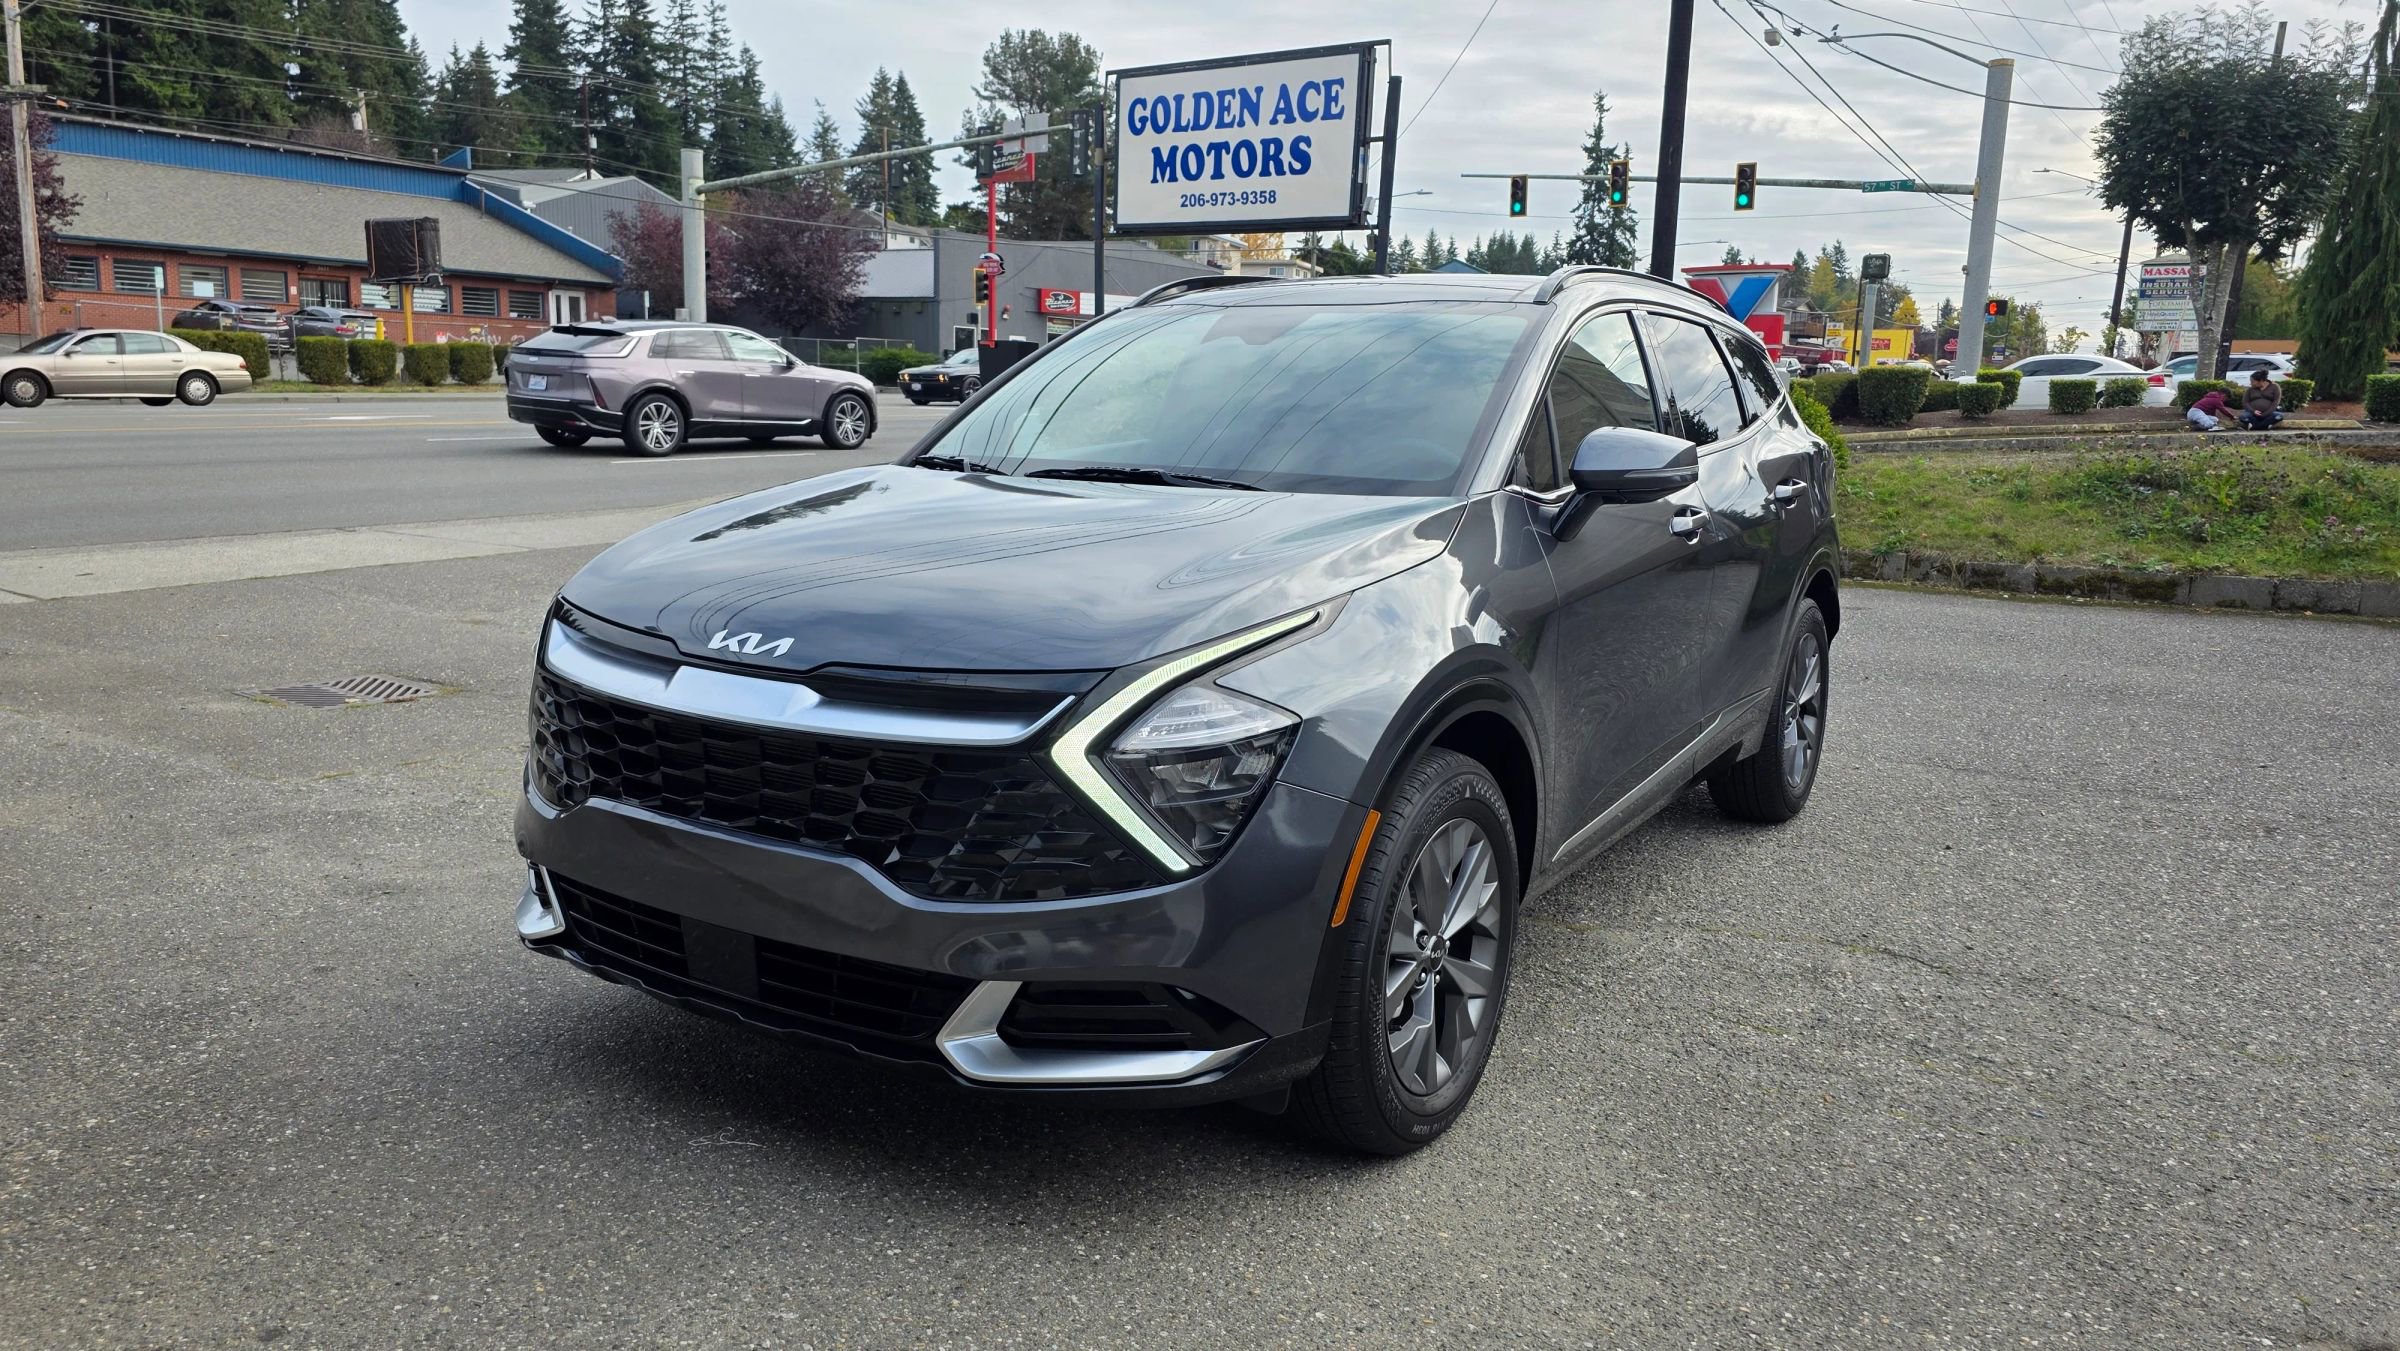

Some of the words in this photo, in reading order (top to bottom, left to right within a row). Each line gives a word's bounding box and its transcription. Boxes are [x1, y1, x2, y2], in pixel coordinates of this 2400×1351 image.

[1127, 85, 1264, 136] GOLDEN
[1269, 77, 1345, 126] ACE
[1150, 134, 1313, 184] MOTORS
[1180, 189, 1277, 208] 206-973-9358
[1864, 182, 1877, 192] 57
[1890, 181, 1902, 190] ST
[2143, 267, 2204, 276] MASSAE
[707, 629, 795, 658] KIA
[1377, 853, 1410, 957] KUMHO
